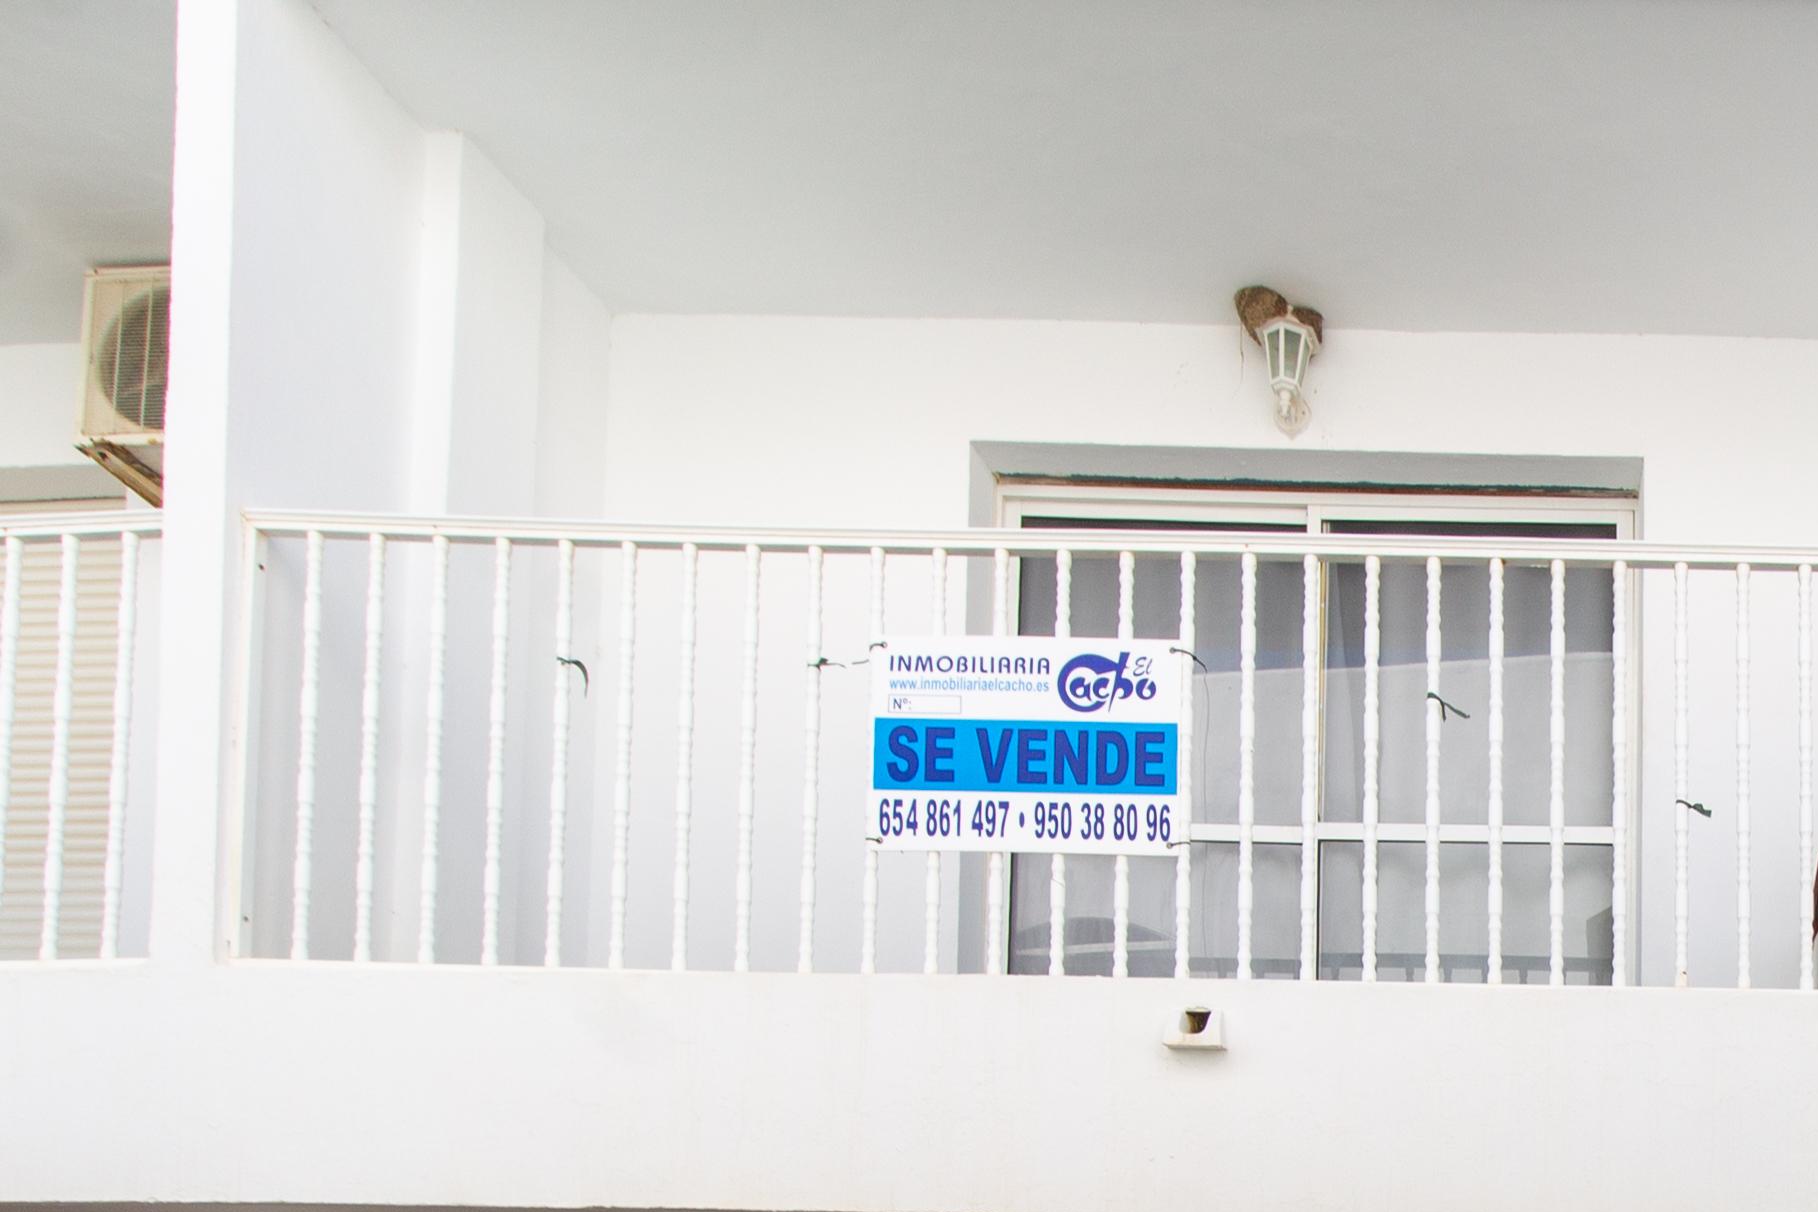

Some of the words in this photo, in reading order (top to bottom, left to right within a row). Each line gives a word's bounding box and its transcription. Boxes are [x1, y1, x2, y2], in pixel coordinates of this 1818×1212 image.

[889, 655, 1050, 675] INMOBILIARIA
[1133, 657, 1153, 675] El
[889, 677, 1050, 692] www.inmobiliariaelcacho.es
[1057, 651, 1156, 712] Cacho
[886, 725, 955, 782] SE
[976, 727, 1165, 787] VENDE
[879, 798, 917, 836] 654
[926, 799, 961, 836] 861
[972, 801, 1010, 837] 497
[1034, 802, 1072, 838] 950
[1080, 803, 1105, 840] 38
[1113, 804, 1137, 841] 80
[1147, 805, 1170, 841] 96
